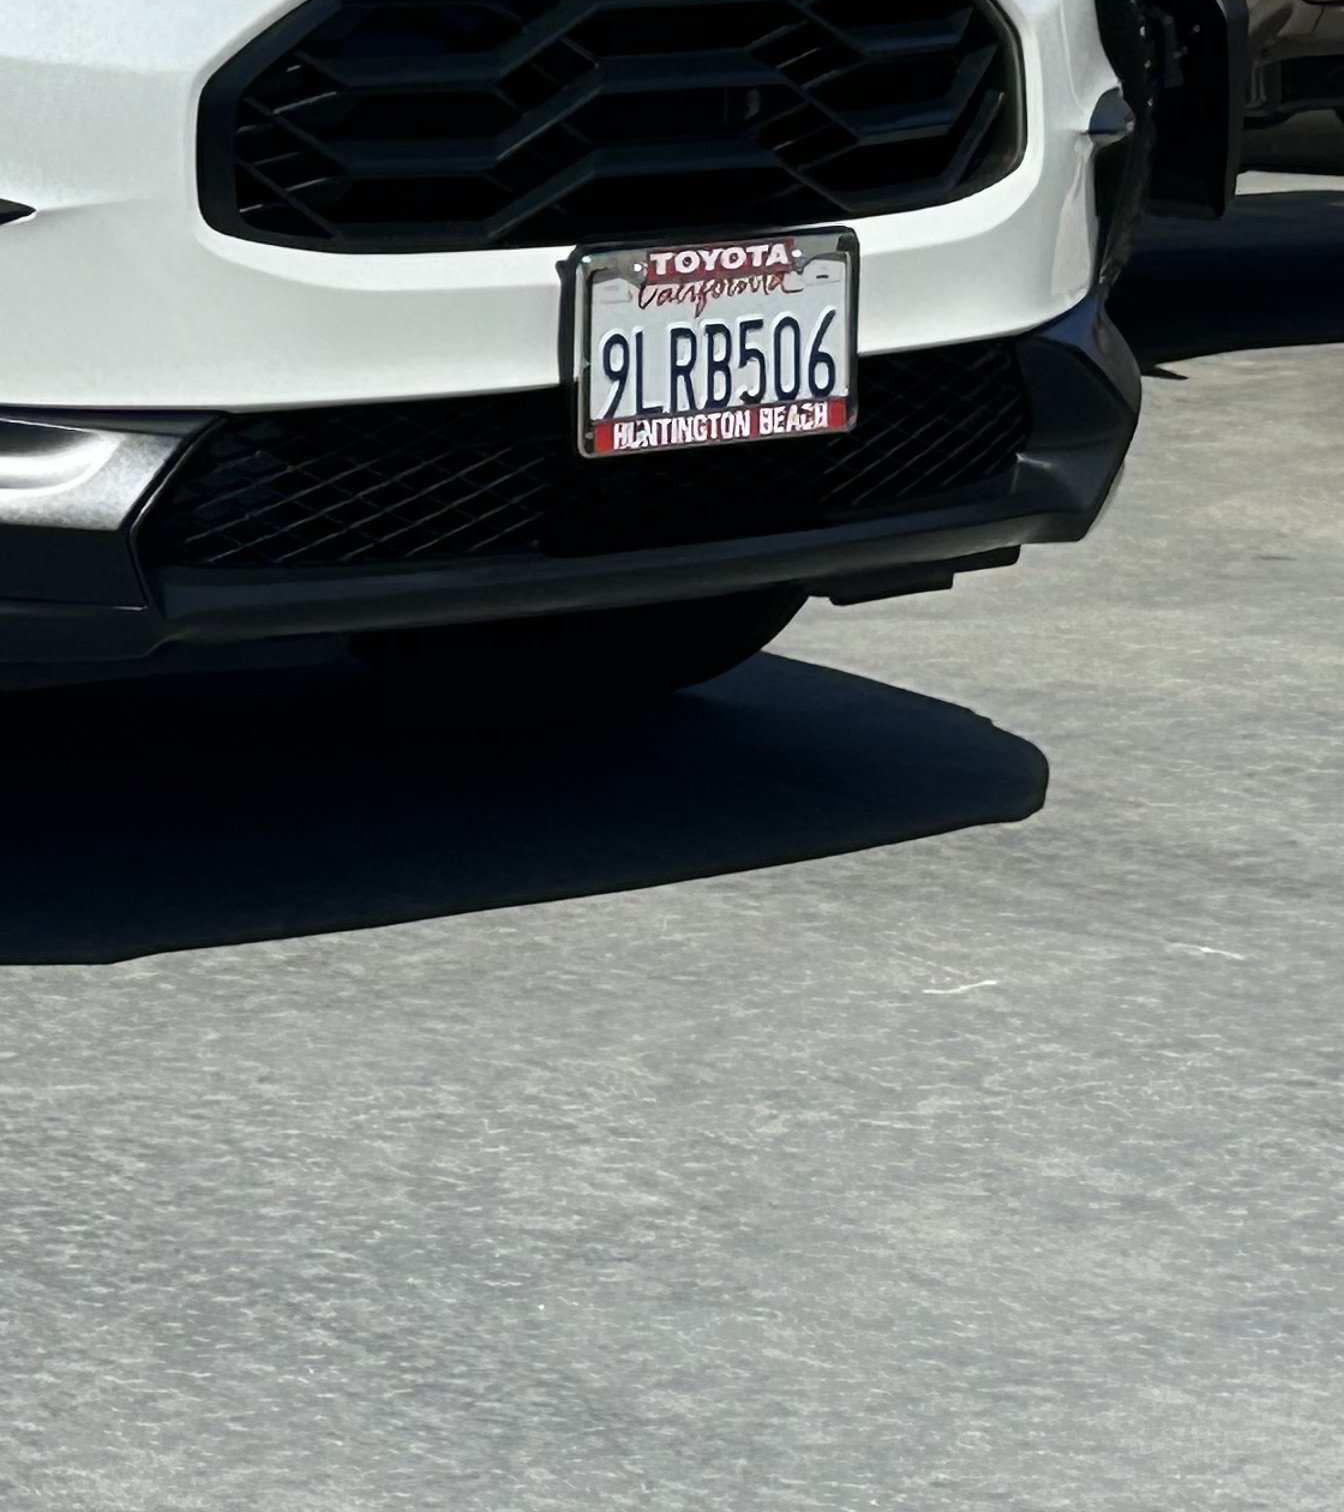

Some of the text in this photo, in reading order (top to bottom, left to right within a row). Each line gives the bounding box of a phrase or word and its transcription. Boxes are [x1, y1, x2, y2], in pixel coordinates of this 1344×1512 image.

[650, 243, 792, 276] TOYOTA
[601, 309, 837, 419] 9LRB506
[613, 401, 829, 451] HUNTINGTON BEACH
